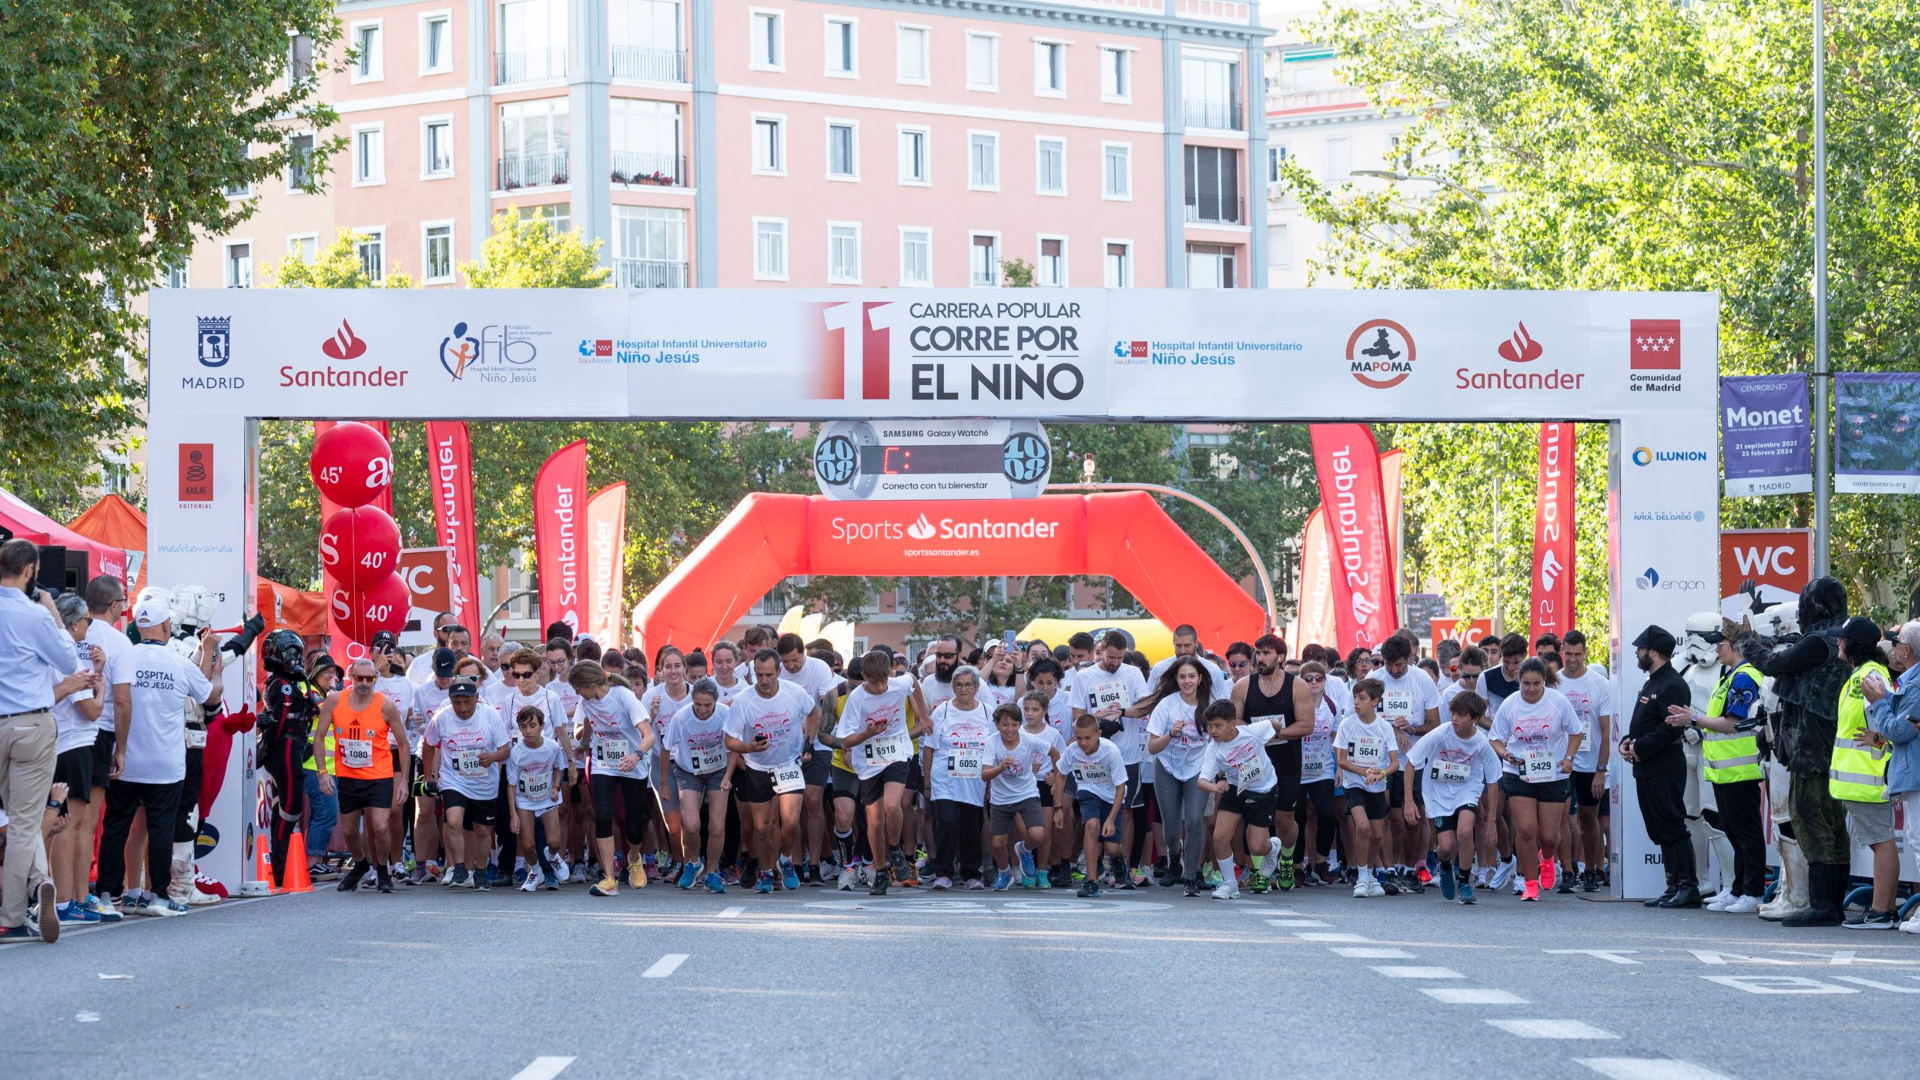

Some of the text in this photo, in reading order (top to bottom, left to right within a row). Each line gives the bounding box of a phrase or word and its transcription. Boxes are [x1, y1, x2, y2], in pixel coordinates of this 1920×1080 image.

[910, 303, 1081, 318] CARRERA POPULAR
[909, 325, 1079, 351] CORRE POR
[481, 324, 537, 364] fib
[617, 339, 767, 350] Hospital Infantil Universitario
[1152, 341, 1302, 352] Hospital Infantil Universitario
[616, 351, 700, 364] Niño Jesús
[1152, 352, 1236, 365] Niño Jesús
[1350, 361, 1412, 373] MAPOMA
[280, 366, 408, 387] Santander
[480, 373, 537, 383] Niño Jesús
[912, 354, 1084, 401] EL NIÑO
[1456, 368, 1585, 390] Santander
[1630, 374, 1682, 383] Comunidad
[182, 377, 244, 389] MADRID
[1630, 383, 1681, 392] de Madrid
[1726, 405, 1803, 427] Monet
[883, 429, 989, 439] SAMSUNG Galaxy Watch6
[1744, 442, 1780, 450] septiembre
[1656, 451, 1707, 461] ILUNION
[185, 486, 207, 495] KAILAS
[882, 481, 918, 490] Conecta
[937, 482, 946, 490] tu
[947, 481, 988, 490] bienestar
[1759, 482, 1791, 490] MADRID
[832, 518, 1059, 544] Sports Santander
[157, 542, 233, 553] mediterránea
[555, 484, 576, 606] Santander
[904, 548, 980, 557] sportssantander.es
[360, 551, 387, 568] 40'
[1734, 546, 1796, 575] WC
[593, 519, 612, 625] Santander
[1661, 580, 1705, 591] ergon
[366, 605, 392, 622] 40'
[135, 670, 175, 681] OSPITAL
[1100, 692, 1120, 702] 6064
[1388, 701, 1408, 709] 5640
[349, 750, 368, 758] 1080
[1359, 747, 1378, 756] 5641
[704, 754, 722, 764] 6561
[960, 760, 978, 768] 6052
[1304, 762, 1322, 770] 5238
[1530, 762, 1552, 771] 5429
[780, 771, 800, 780] 6562
[530, 782, 548, 792] 6083
